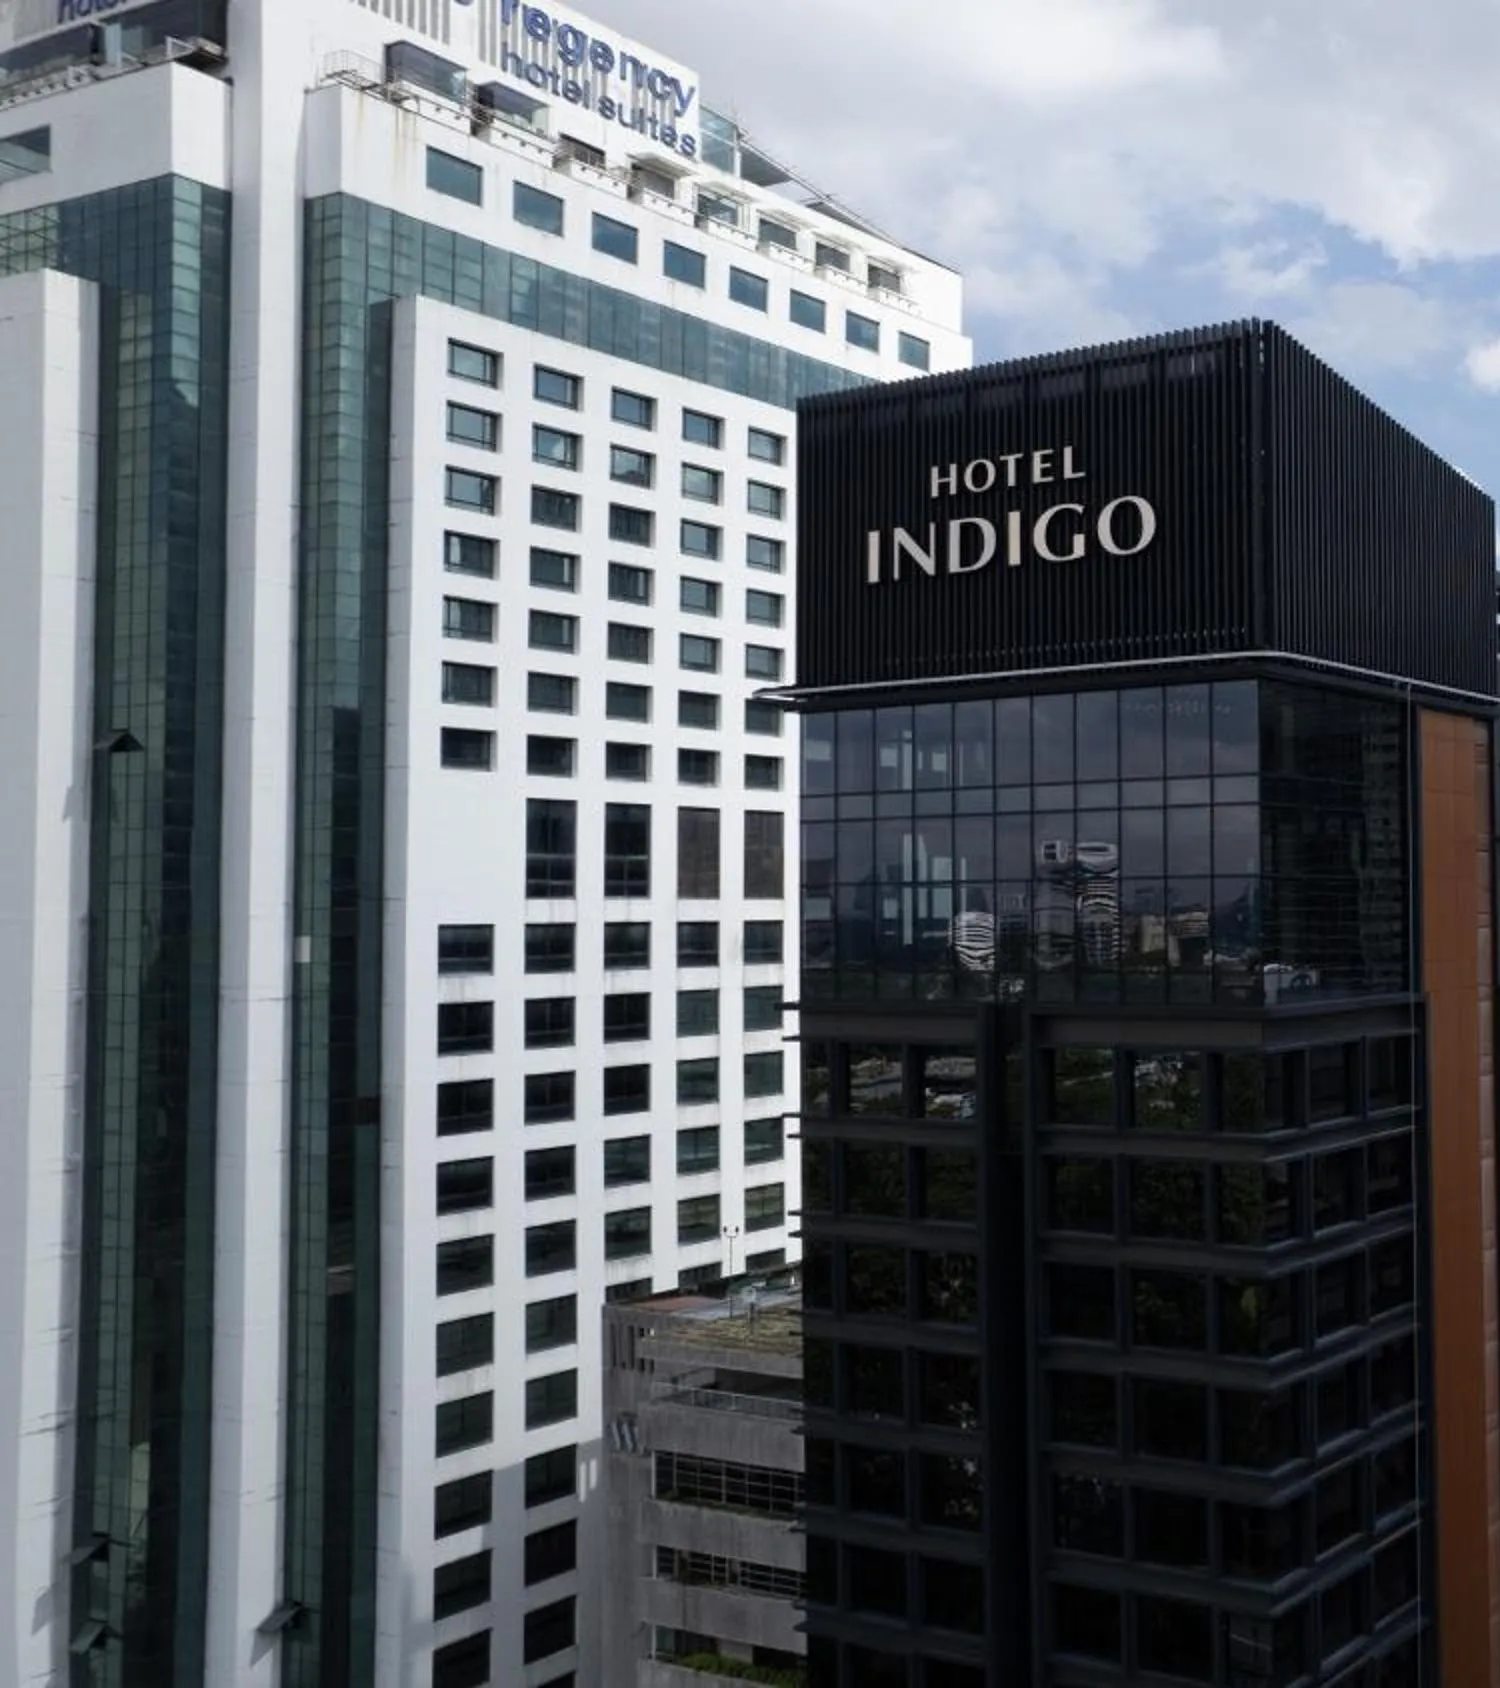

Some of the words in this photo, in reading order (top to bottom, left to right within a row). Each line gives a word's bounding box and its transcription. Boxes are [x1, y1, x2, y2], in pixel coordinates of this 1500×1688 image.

[502, 0, 695, 117] regency
[502, 41, 590, 110] hotel
[598, 95, 696, 157] suites
[931, 446, 1086, 498] HOTEL
[867, 495, 1157, 584] INDIGO
